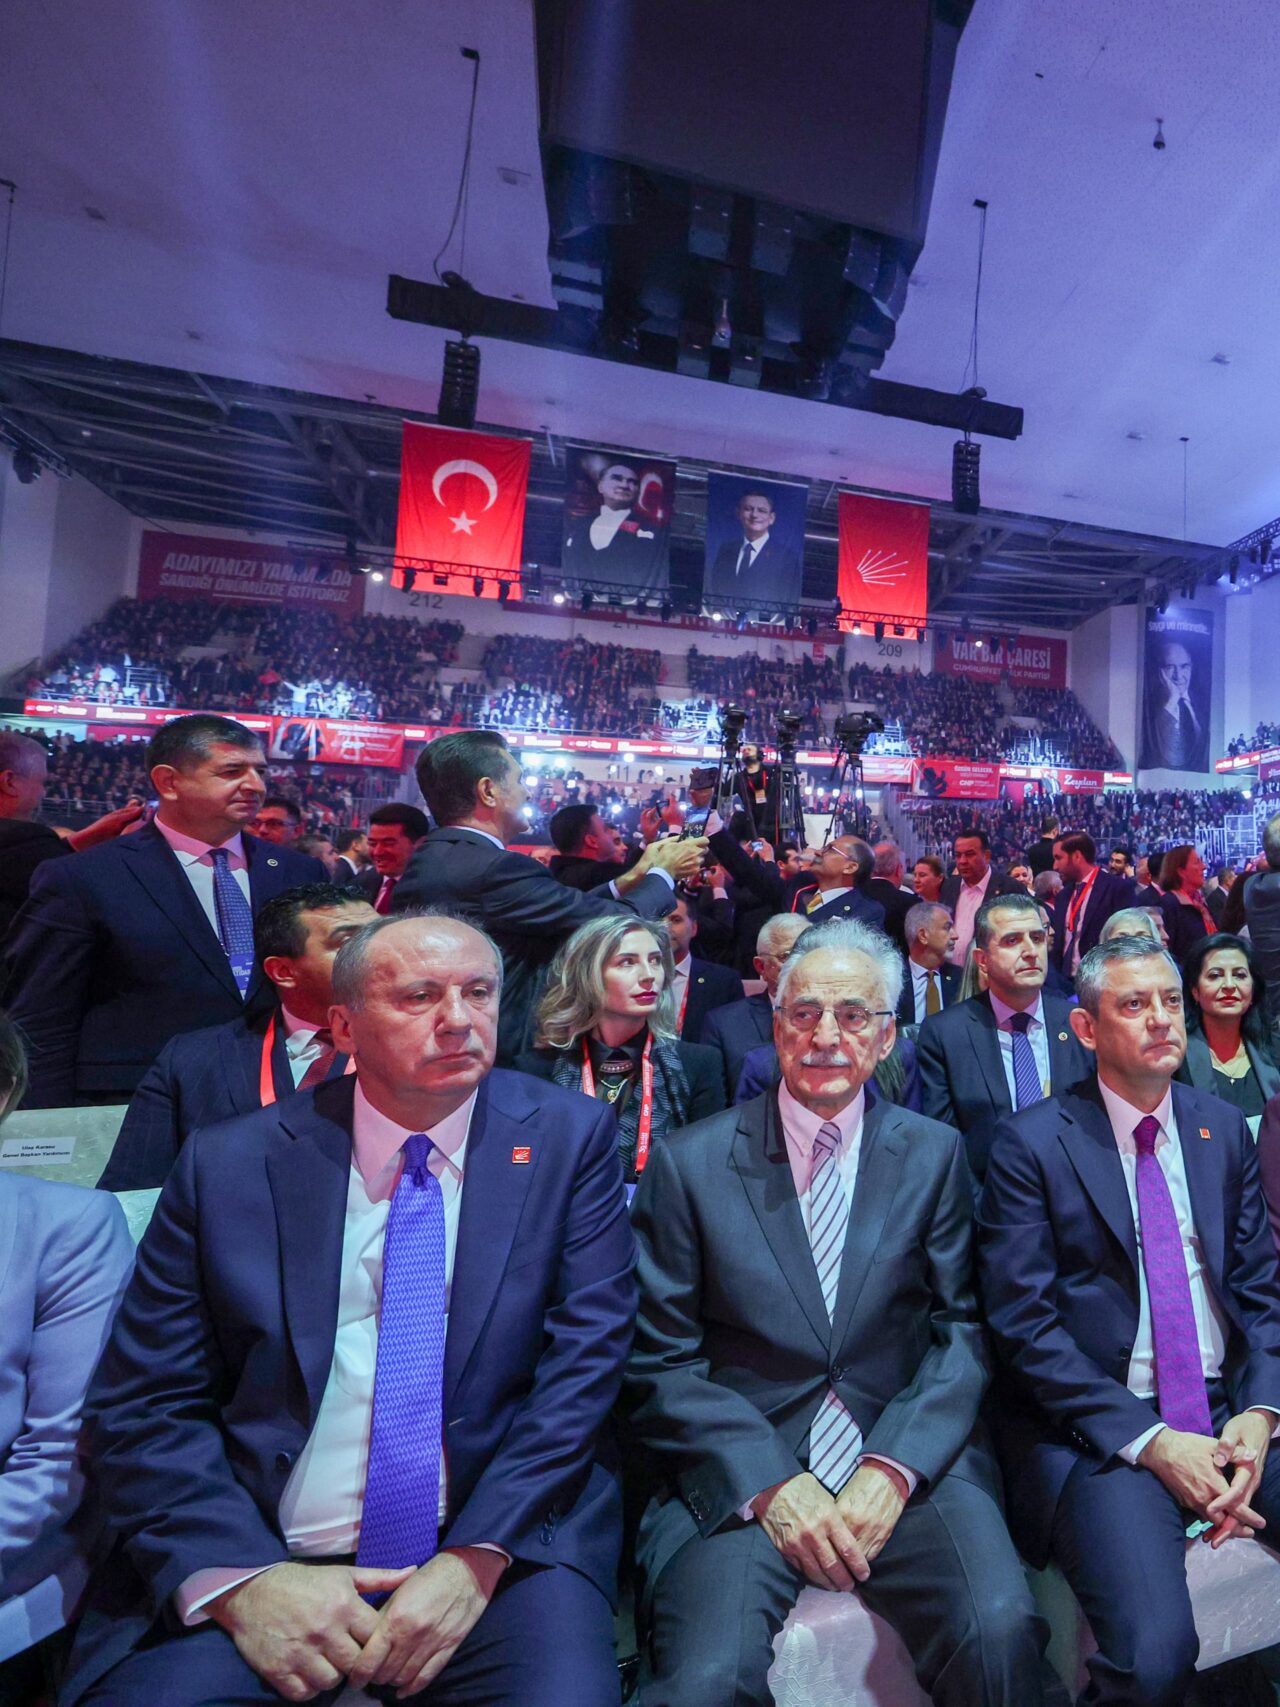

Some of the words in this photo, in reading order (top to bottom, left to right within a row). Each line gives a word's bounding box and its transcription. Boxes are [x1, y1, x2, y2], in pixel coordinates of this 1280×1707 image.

[163, 552, 255, 577] ADAYIMIZI
[410, 592, 443, 608] 212
[878, 643, 902, 657] 209
[952, 640, 977, 661] VAR
[1007, 647, 1051, 669] ÇARESİ
